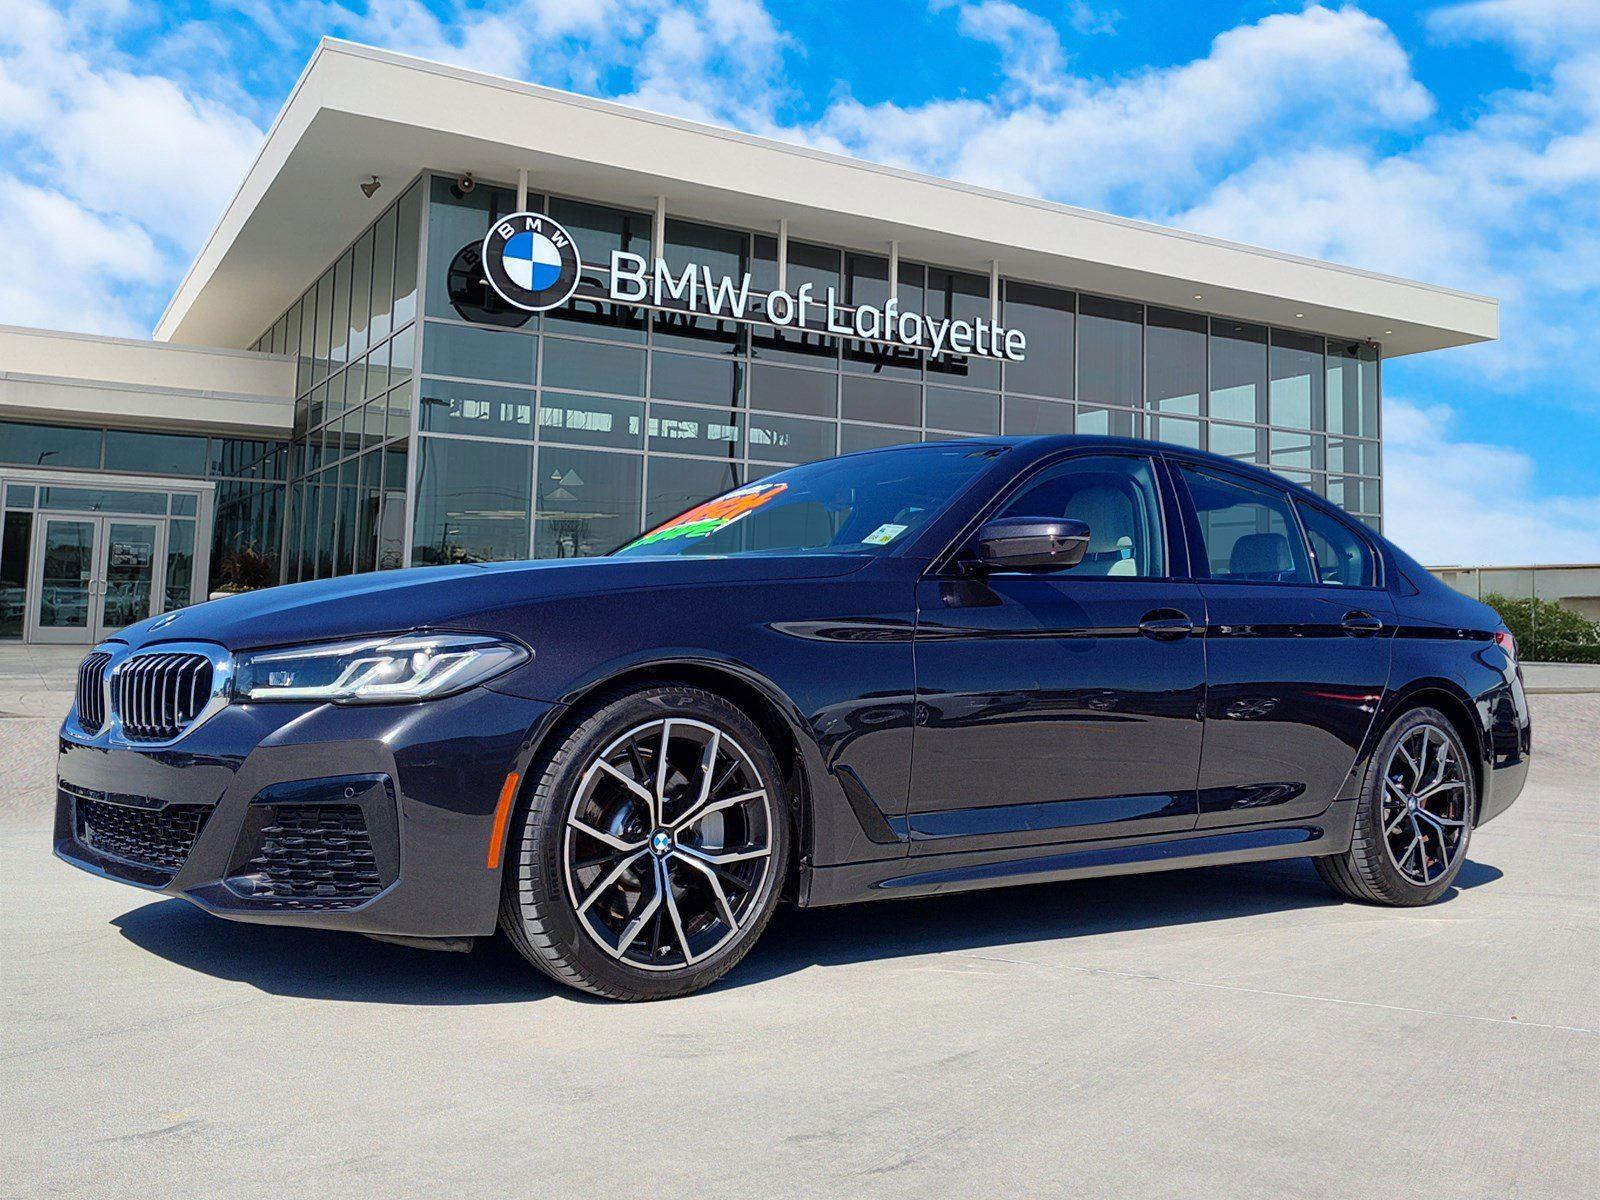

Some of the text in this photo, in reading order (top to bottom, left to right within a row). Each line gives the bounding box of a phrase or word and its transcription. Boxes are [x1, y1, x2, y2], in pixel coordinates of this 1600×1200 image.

[497, 217, 569, 248] BMW
[610, 250, 1027, 362] BMW of Lafayette
